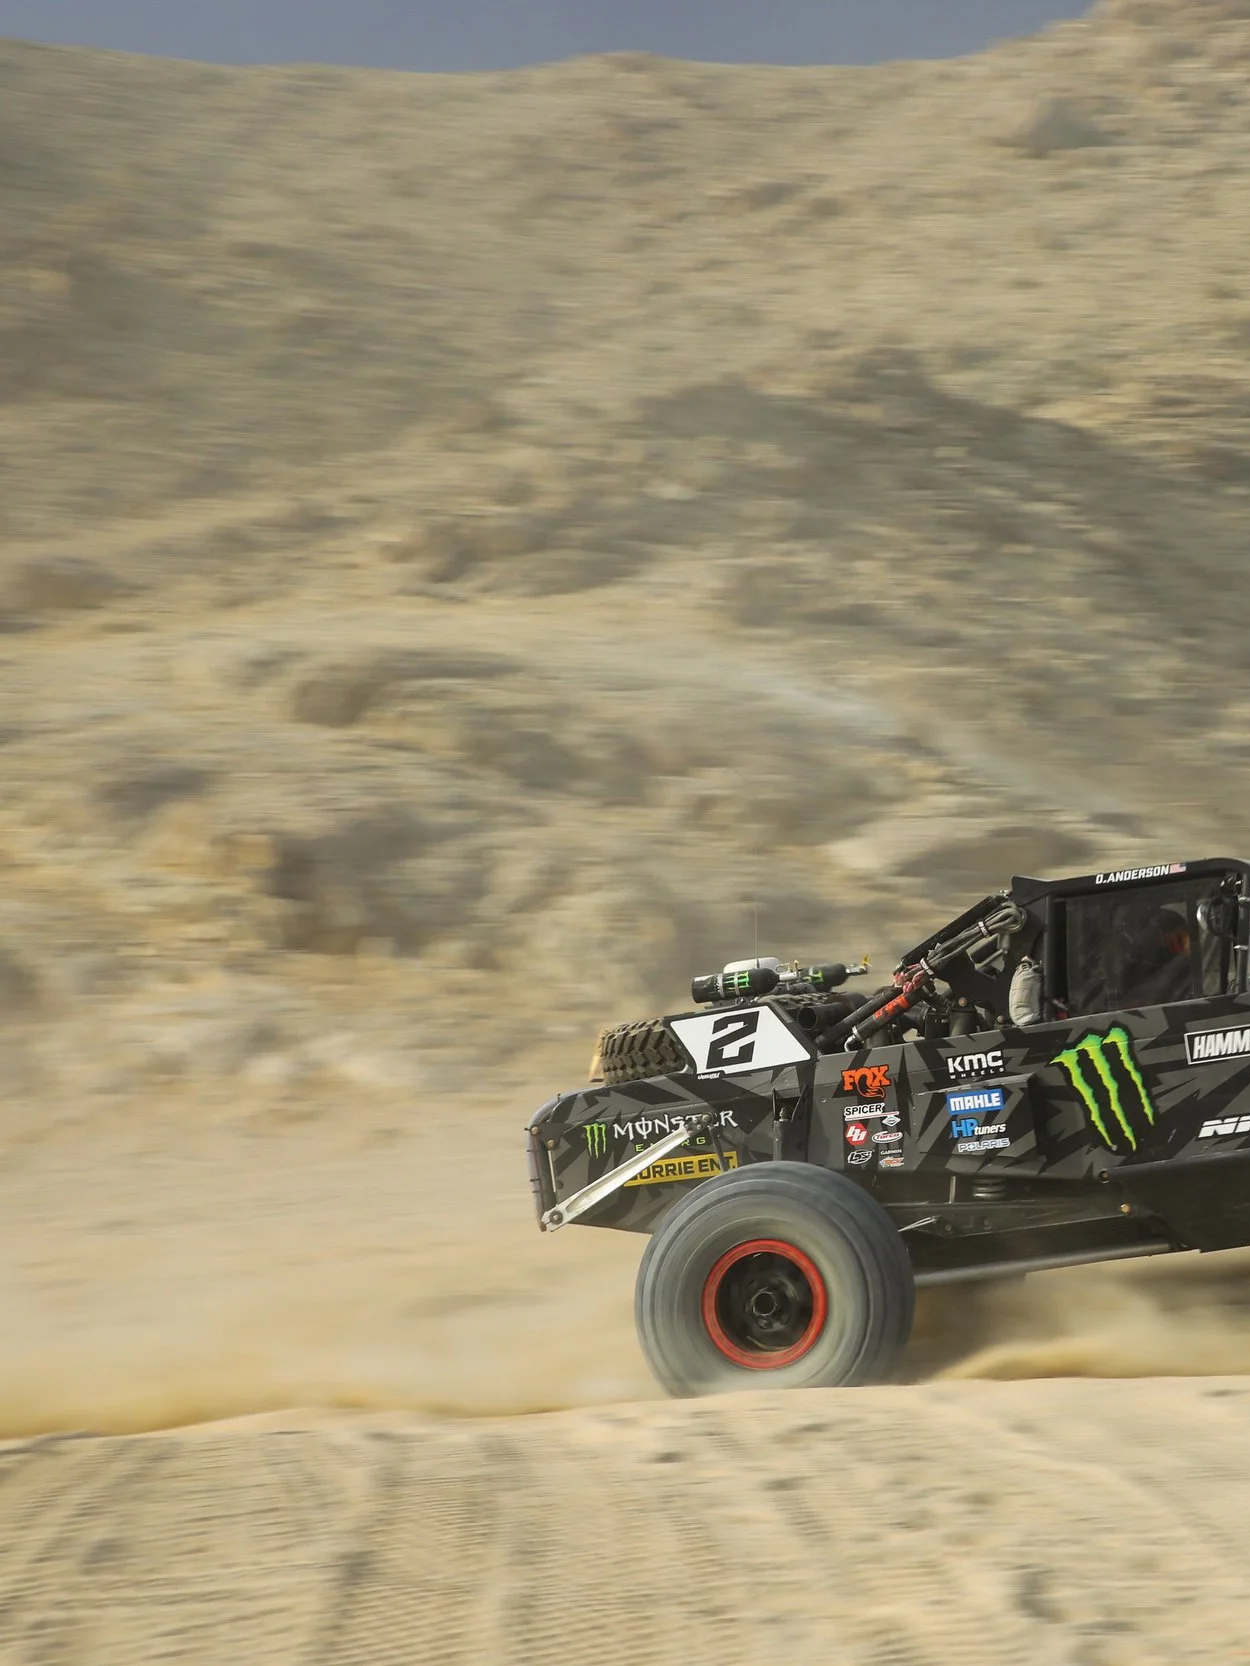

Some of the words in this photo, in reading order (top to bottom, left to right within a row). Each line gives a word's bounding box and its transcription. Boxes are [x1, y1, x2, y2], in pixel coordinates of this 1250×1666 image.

[1095, 864, 1170, 884] D.ANDERSON
[706, 1011, 760, 1070] 2
[947, 1050, 1003, 1073] KMC
[841, 1065, 891, 1098] FOX
[950, 1067, 1004, 1079] WHEELS
[845, 1104, 882, 1116] SPICER
[950, 1092, 1001, 1111] MAHLE
[612, 1110, 738, 1141] MONSTR
[957, 1138, 1010, 1152] POLARIS
